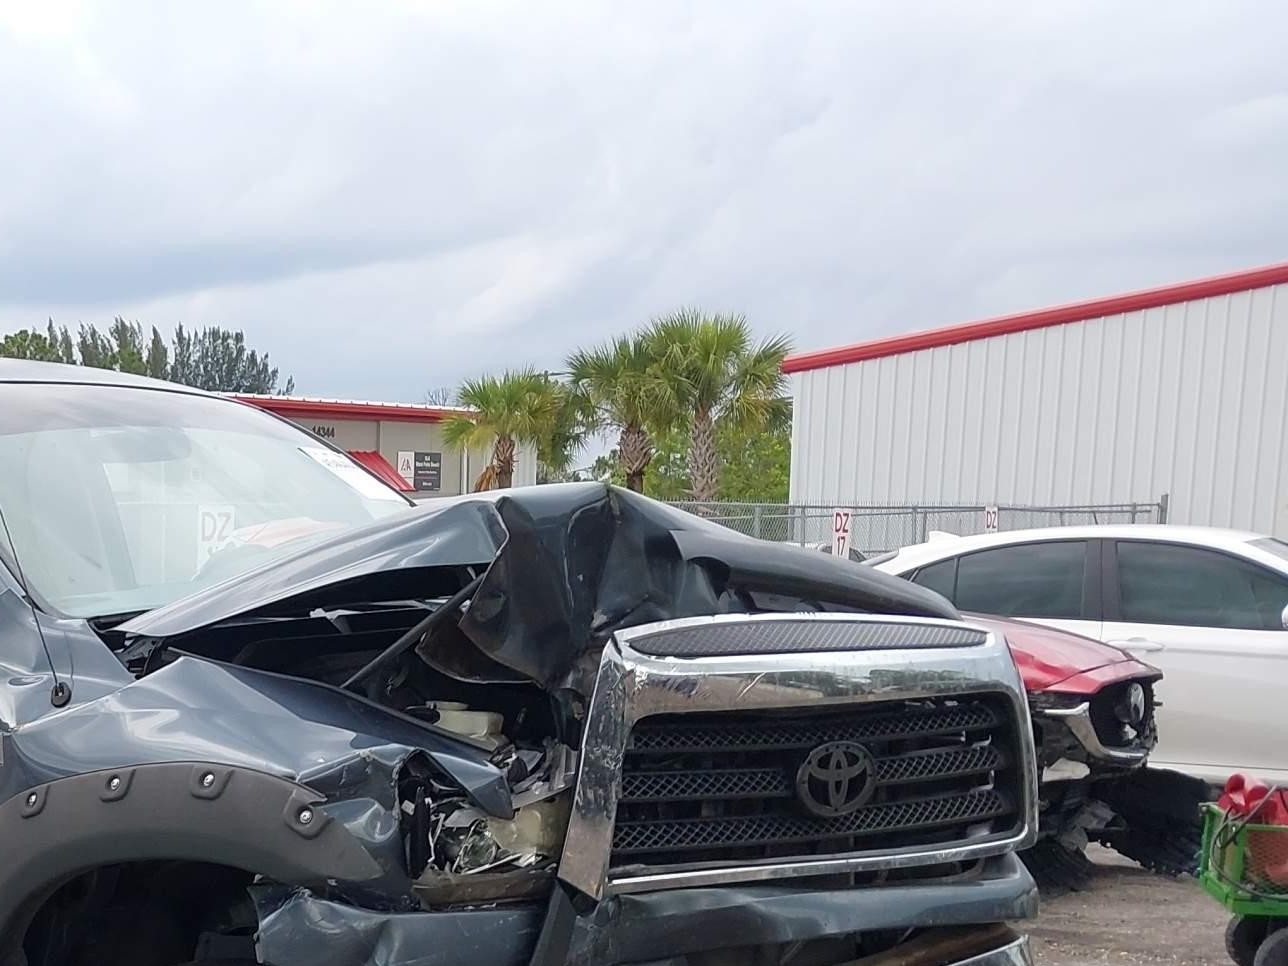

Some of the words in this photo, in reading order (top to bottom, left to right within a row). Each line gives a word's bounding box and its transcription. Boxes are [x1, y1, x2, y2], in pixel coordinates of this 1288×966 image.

[201, 511, 232, 542] DZ
[835, 512, 849, 533] DZ
[986, 511, 997, 529] DZ
[837, 535, 846, 558] 17
